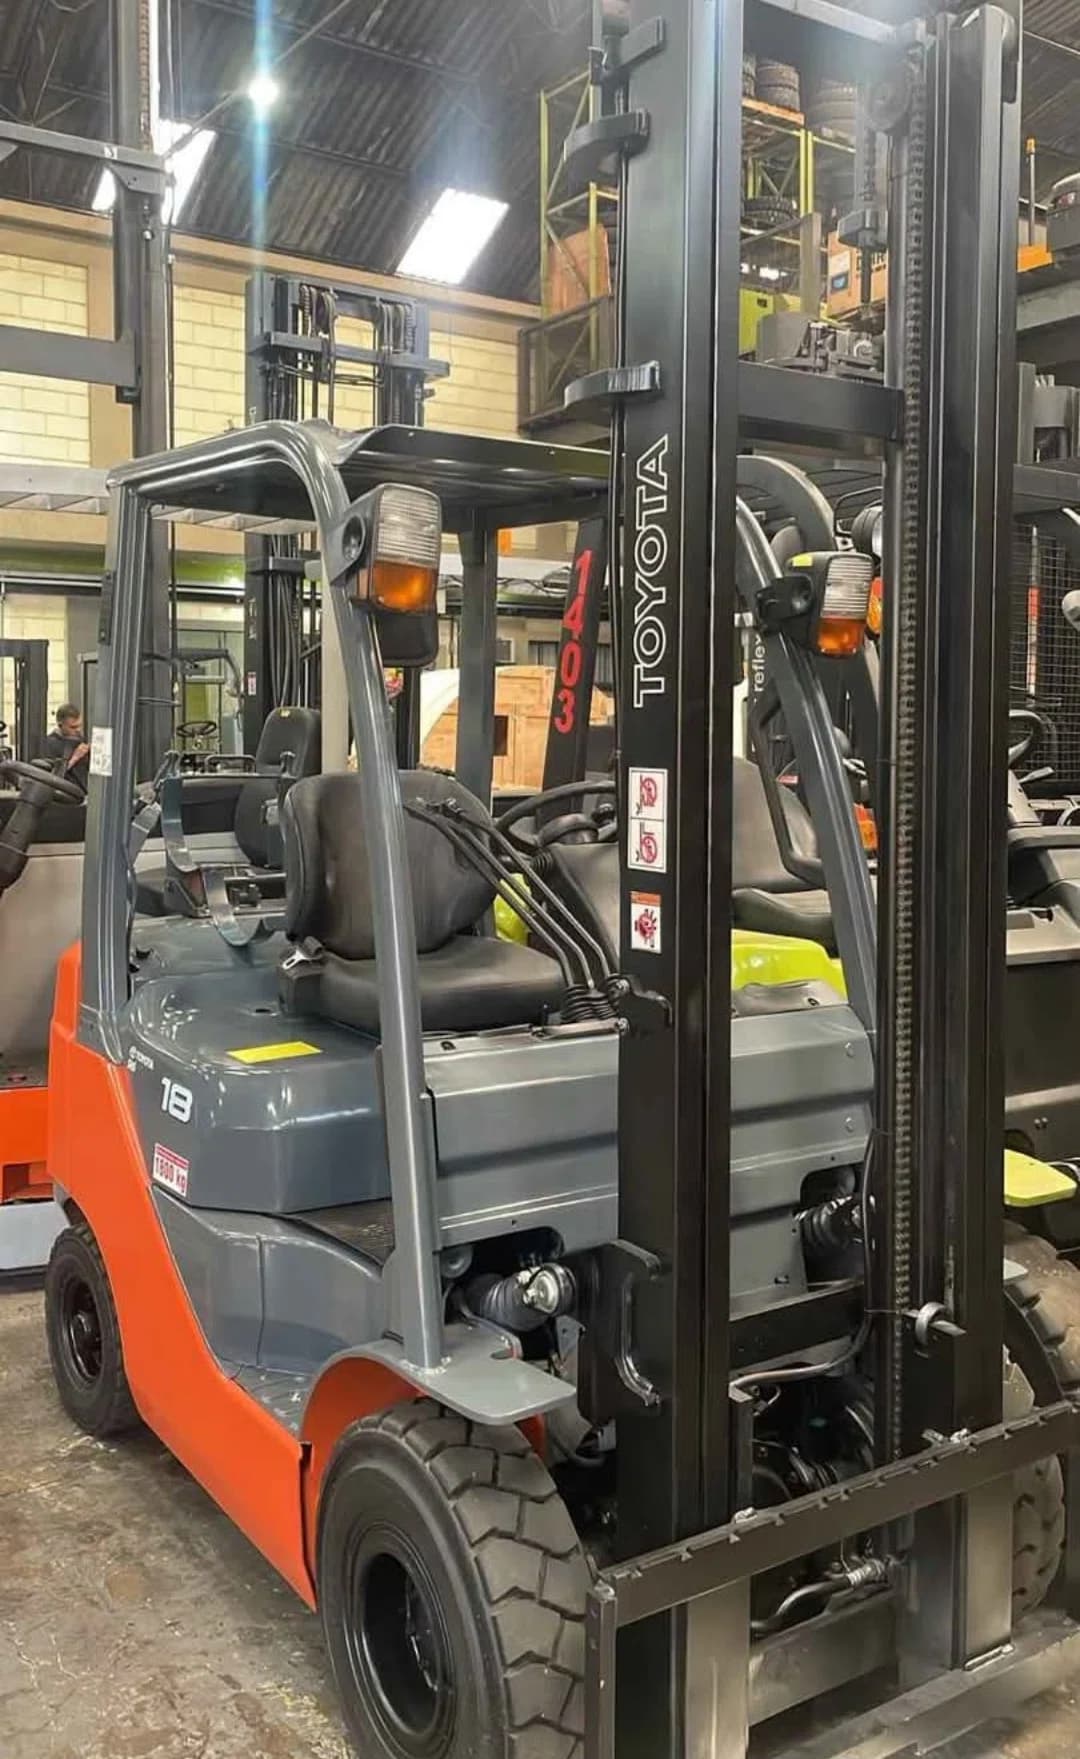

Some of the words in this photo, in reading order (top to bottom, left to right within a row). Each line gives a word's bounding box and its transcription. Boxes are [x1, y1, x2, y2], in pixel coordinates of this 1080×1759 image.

[633, 434, 668, 708] TOYOTA
[554, 550, 592, 734] 1403
[161, 1076, 193, 1123] 18
[176, 1168, 187, 1194] kg
